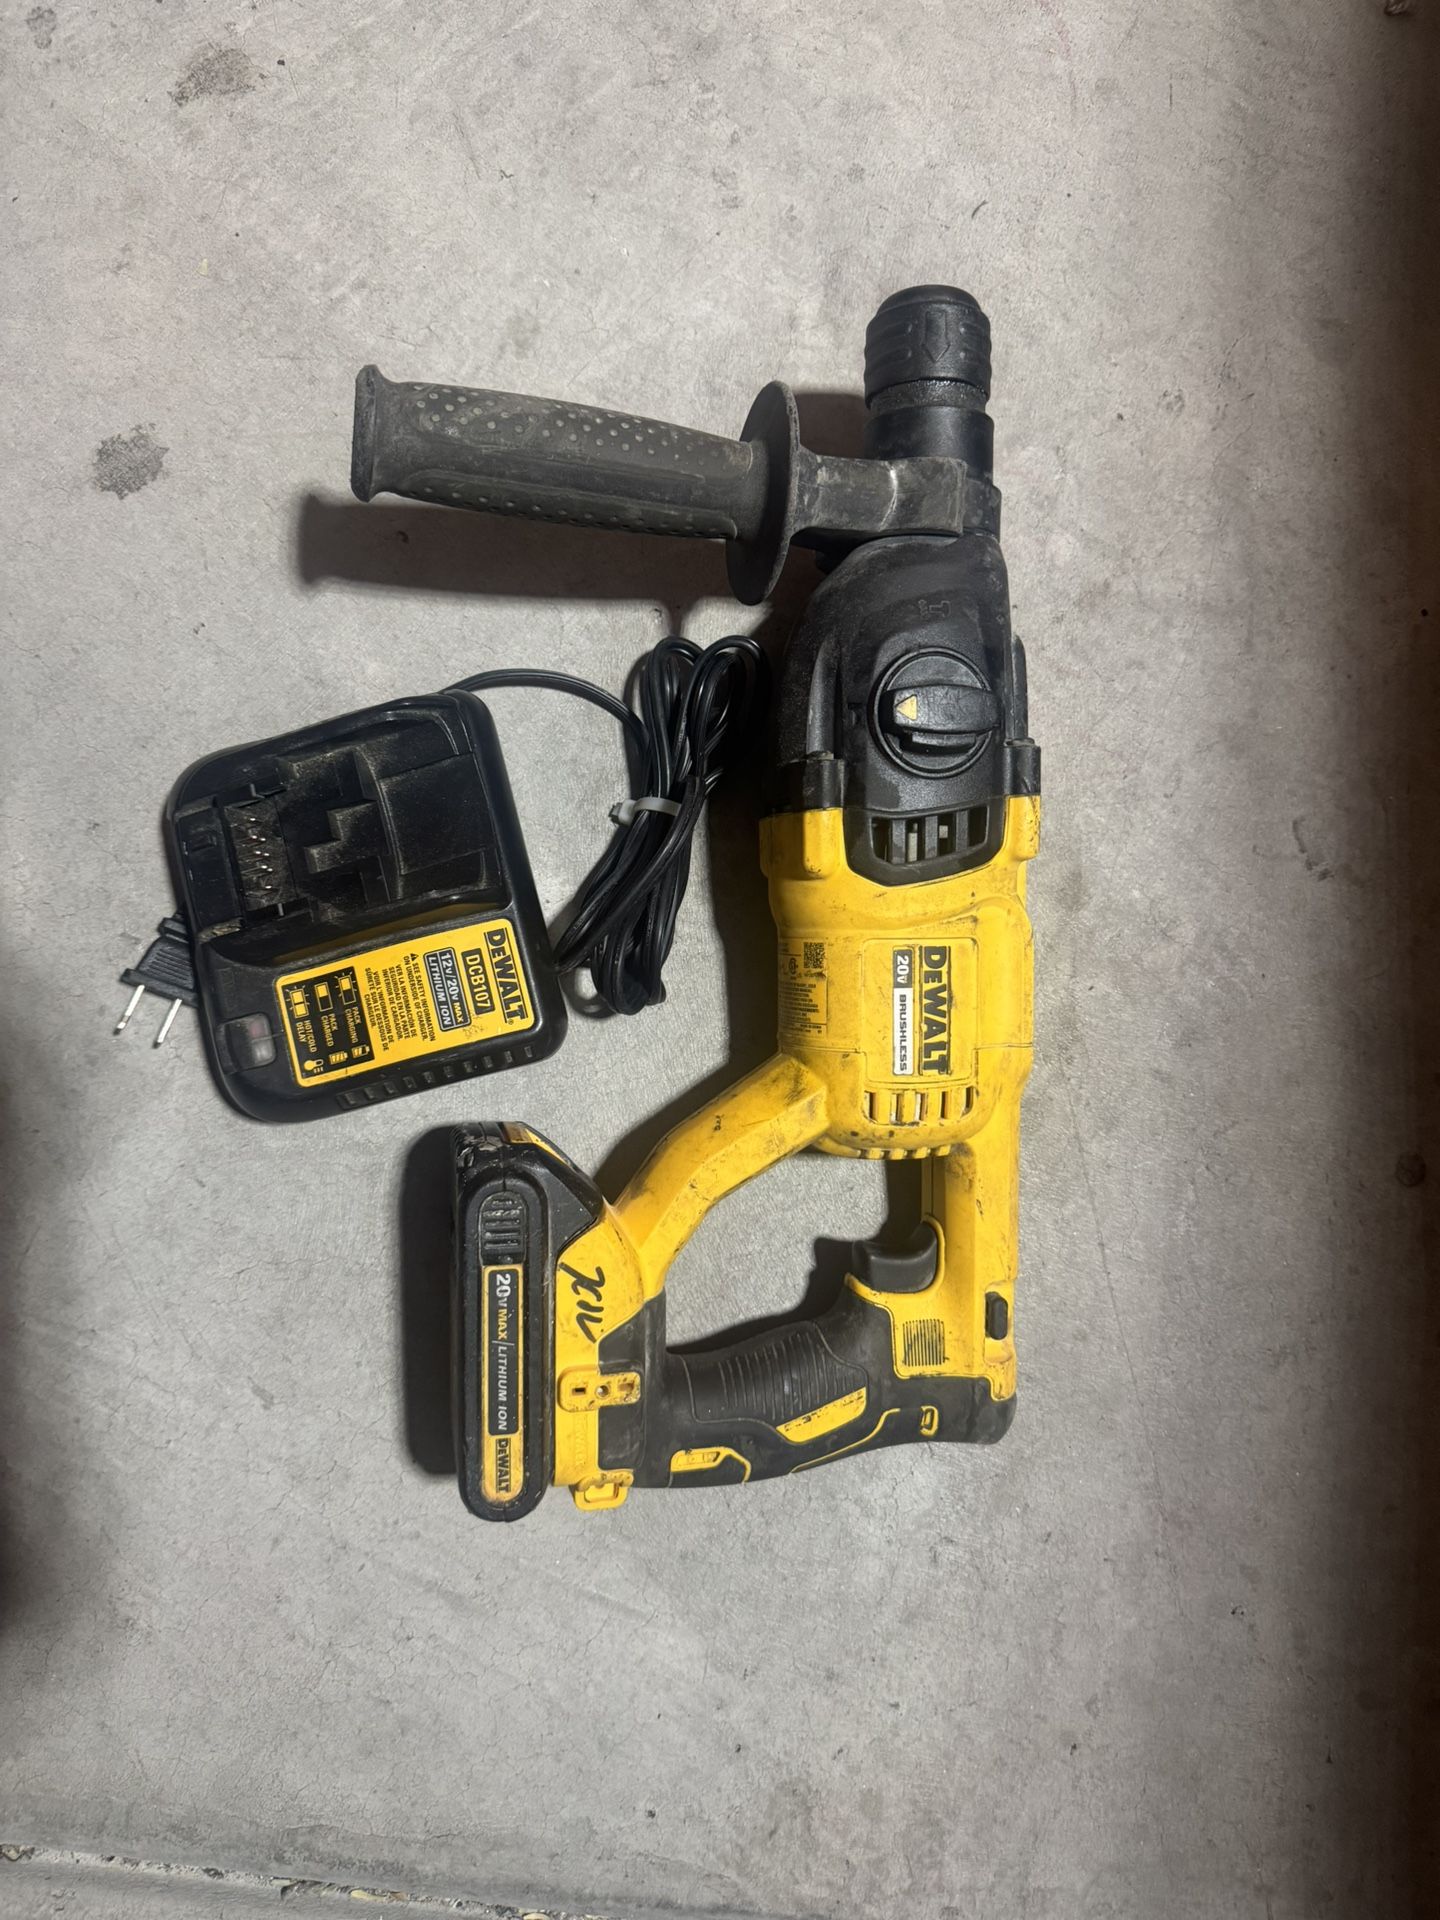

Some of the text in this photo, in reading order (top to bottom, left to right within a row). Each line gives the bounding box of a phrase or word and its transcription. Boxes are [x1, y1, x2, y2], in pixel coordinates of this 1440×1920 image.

[388, 966, 409, 1039] SEGURIDAD EN LA PARTE
[403, 955, 428, 1040] ON UNDERSIDE OF CHARGER.
[412, 962, 435, 1041] SEE SAFETY INFORMATION
[428, 955, 451, 1025] LITHIUM ION
[465, 953, 490, 1008] DCB107
[486, 930, 525, 1021] DEWALT
[295, 1021, 306, 1043] DELAY
[320, 1015, 333, 1046] CHARGED
[328, 1013, 337, 1031] PACK
[344, 1008, 358, 1043] CHARGING
[352, 1006, 361, 1024] PACK
[398, 976, 404, 984] LA
[410, 1028, 417, 1037] DE
[453, 1001, 463, 1022] MAX
[899, 994, 907, 1072] BRUSHLESS
[924, 946, 947, 1074] DEWALT
[303, 1019, 316, 1052] HOT/COLD
[498, 1308, 509, 1340] MAX
[497, 1345, 508, 1401] LITHIUM
[497, 1405, 508, 1431] ION
